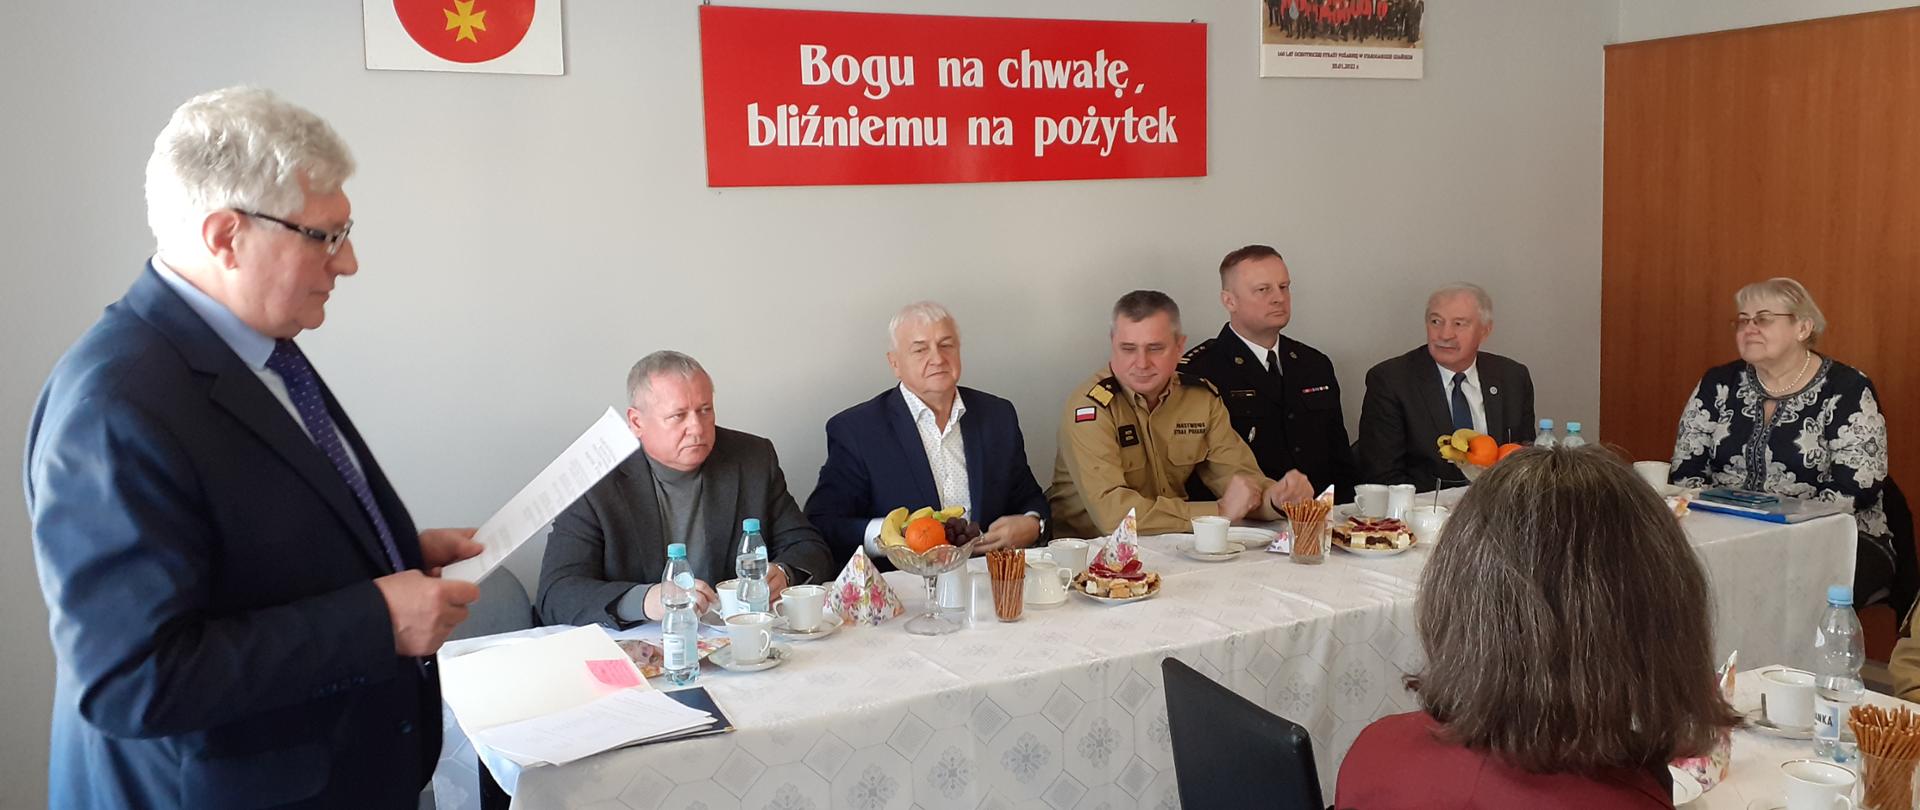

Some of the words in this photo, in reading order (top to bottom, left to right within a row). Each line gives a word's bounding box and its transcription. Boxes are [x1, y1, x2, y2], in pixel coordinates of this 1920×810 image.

[800, 45, 914, 99] Bogu
[939, 58, 983, 87] na
[998, 49, 1144, 98] chwałę,
[748, 103, 947, 147] bliźniemu
[969, 117, 1013, 145] na
[1035, 106, 1177, 156] pożytek
